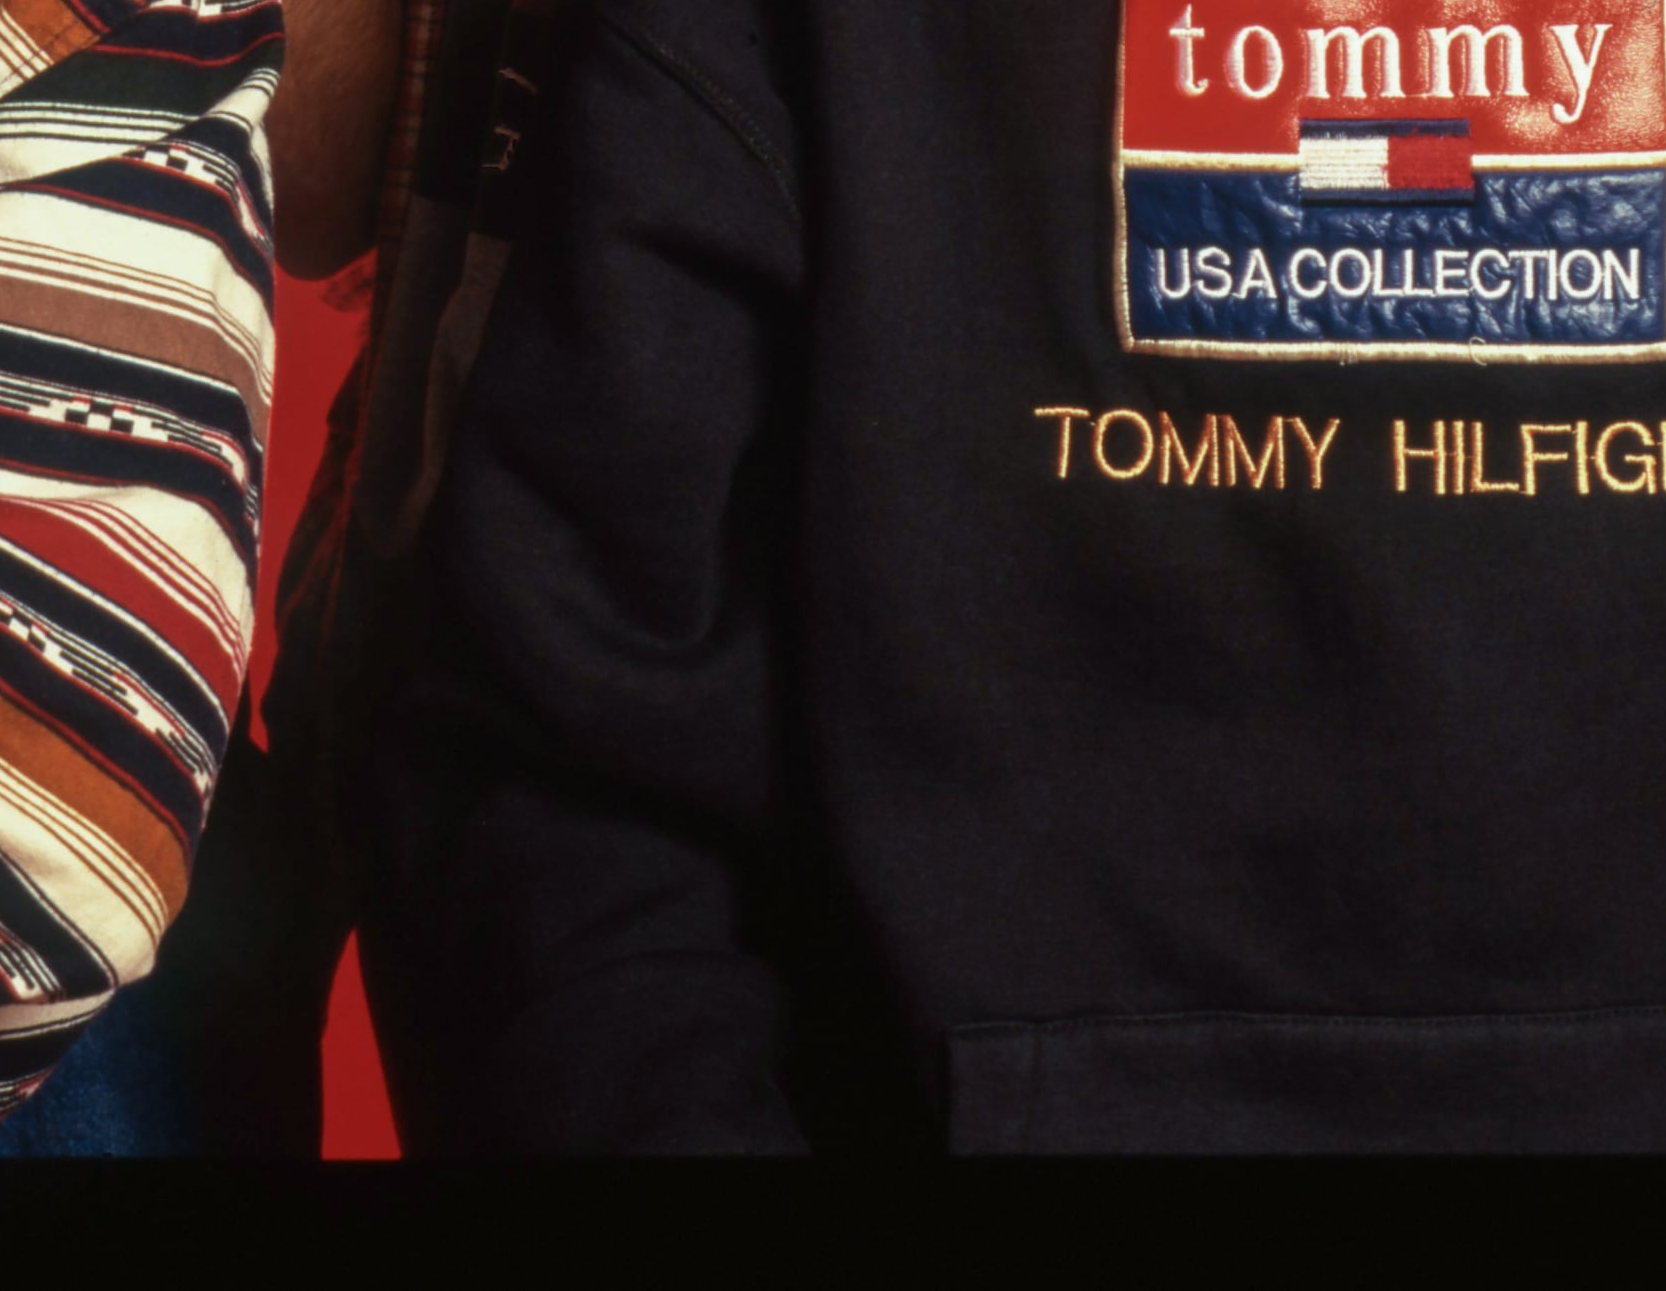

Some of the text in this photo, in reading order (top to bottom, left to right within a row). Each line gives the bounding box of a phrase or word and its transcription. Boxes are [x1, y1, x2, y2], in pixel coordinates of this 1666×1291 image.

[1169, 3, 1613, 124] tommy
[1155, 247, 1640, 301] USA COLLECTION
[1035, 407, 1340, 490] TOMMY
